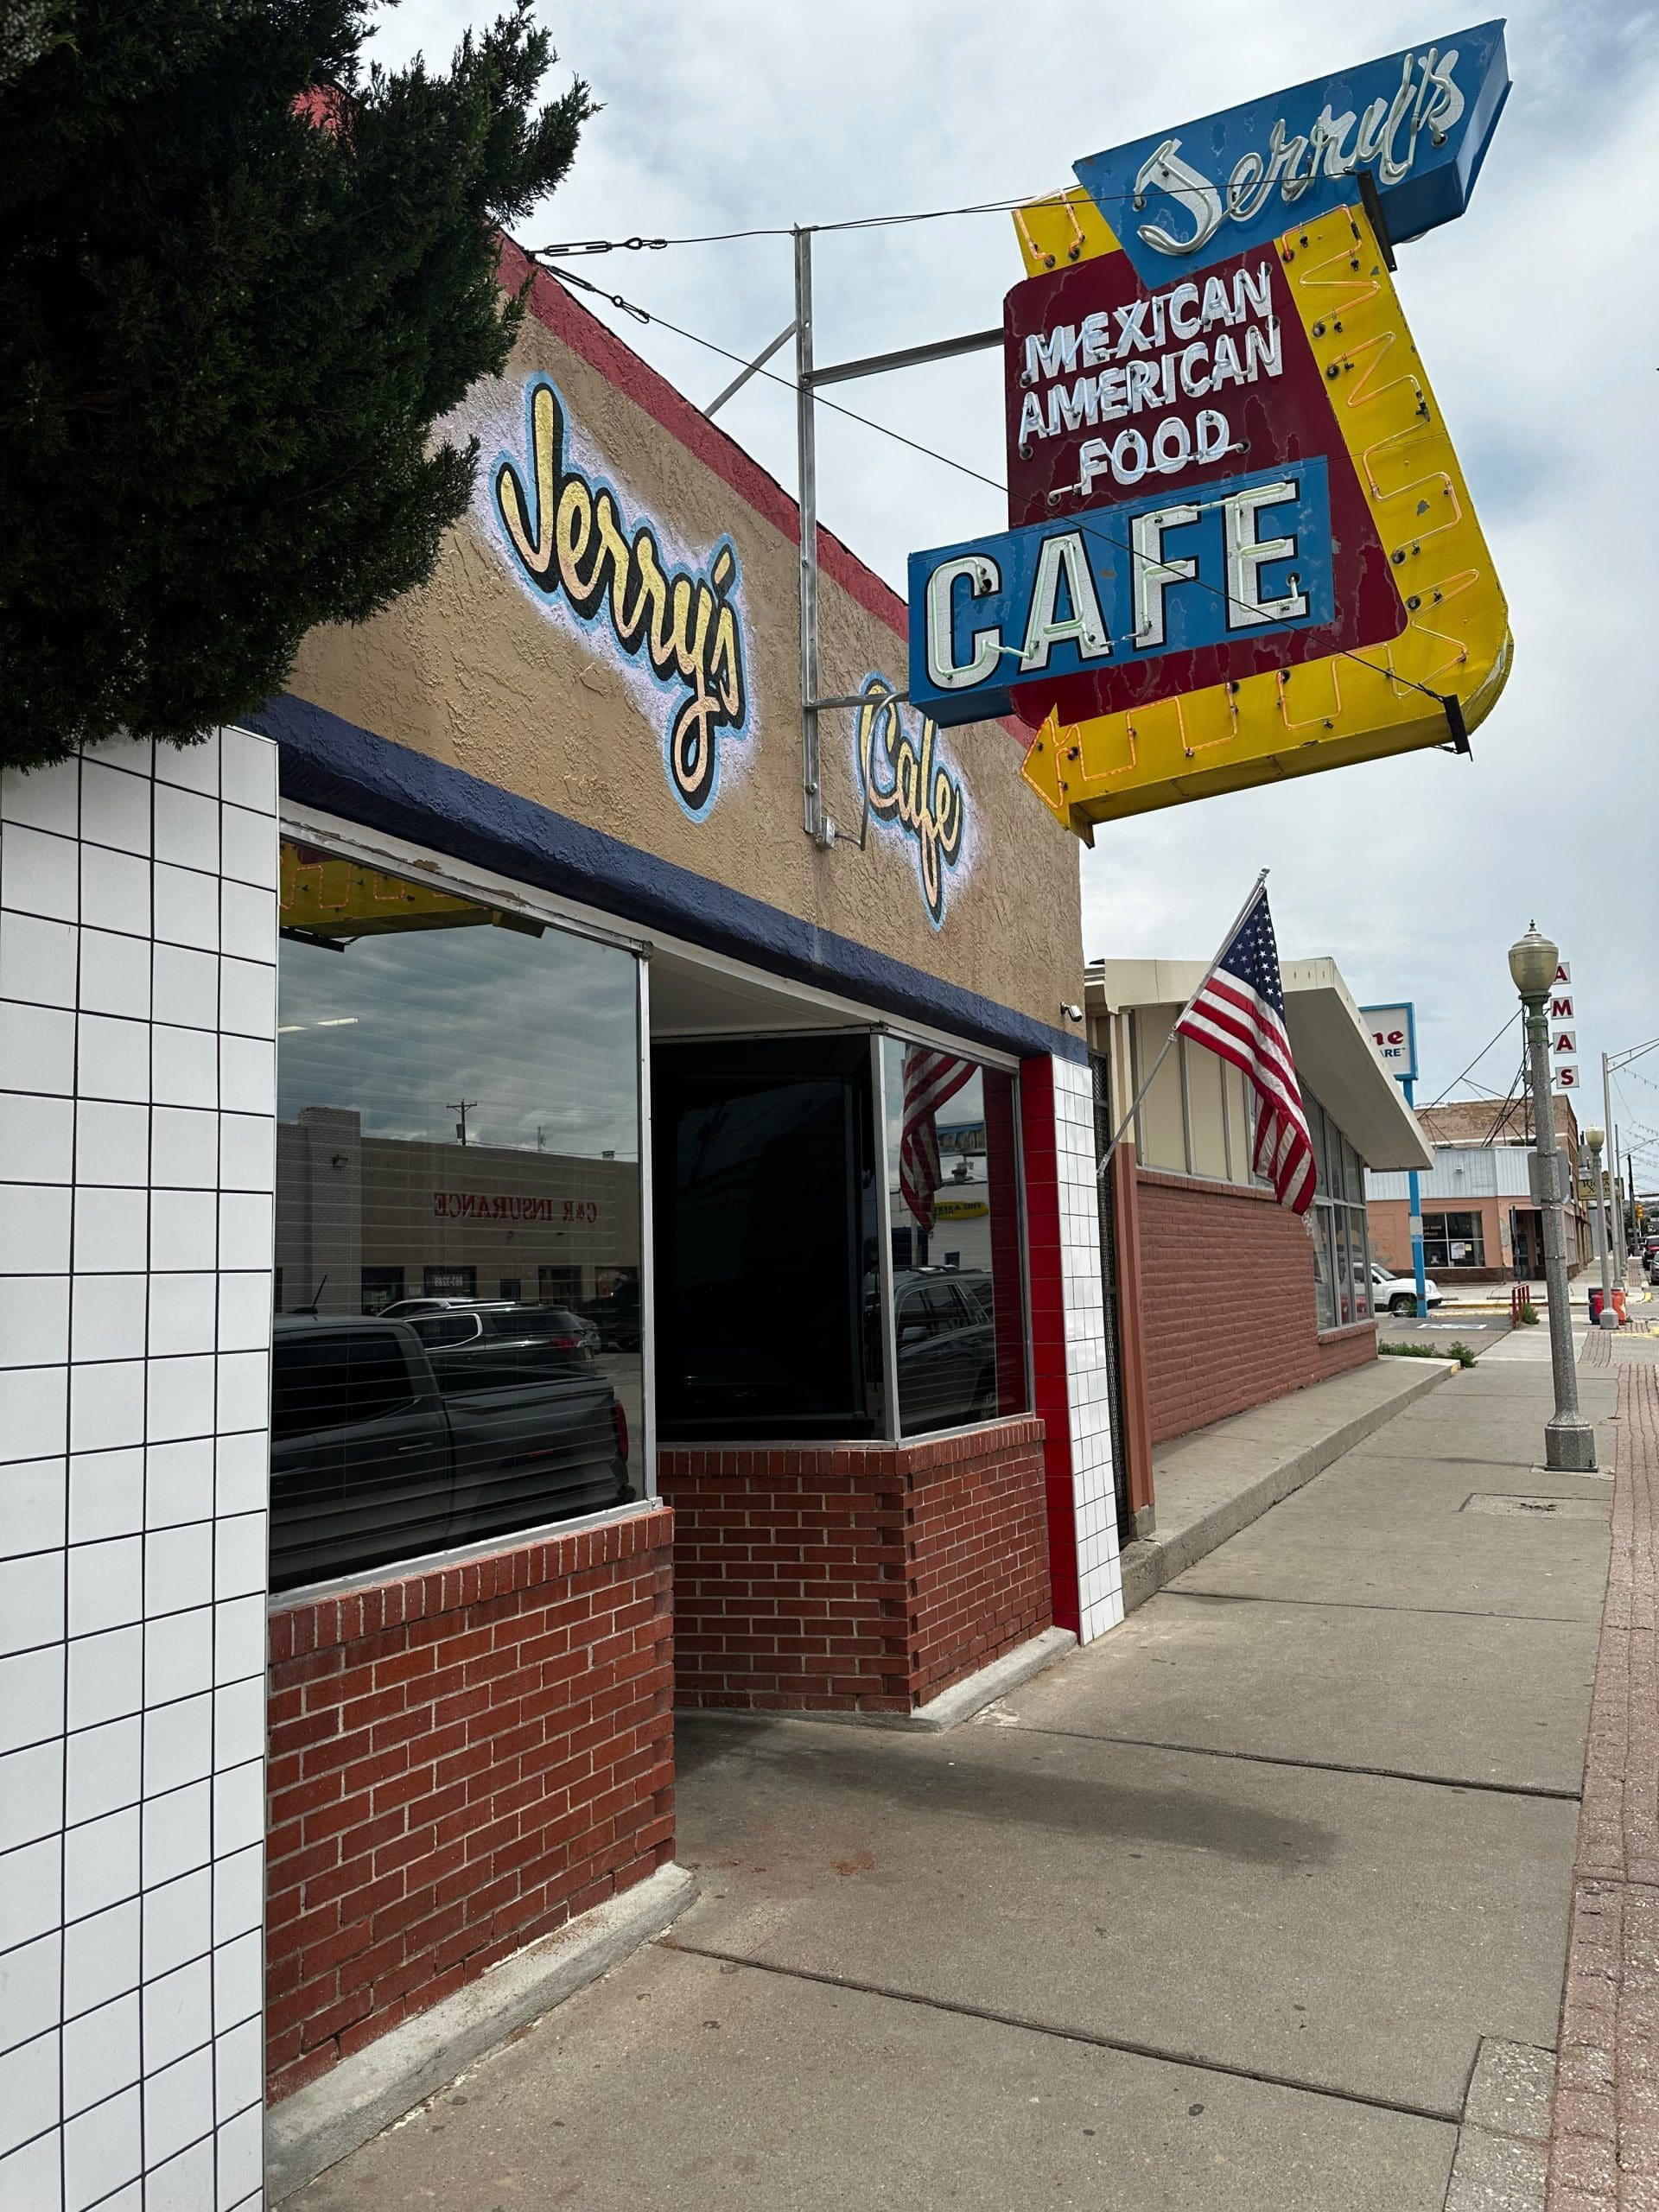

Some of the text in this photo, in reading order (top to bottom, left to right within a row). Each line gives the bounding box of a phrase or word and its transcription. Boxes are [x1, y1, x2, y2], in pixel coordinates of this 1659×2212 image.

[1132, 47, 1465, 255] Jerry's
[1020, 261, 1273, 386] MEXICAN
[1020, 316, 1284, 446] AMERICAN
[1079, 410, 1231, 495] FOOD
[497, 383, 746, 809] Jerry's
[926, 480, 1308, 689] CAFE
[860, 679, 963, 922] Cafe
